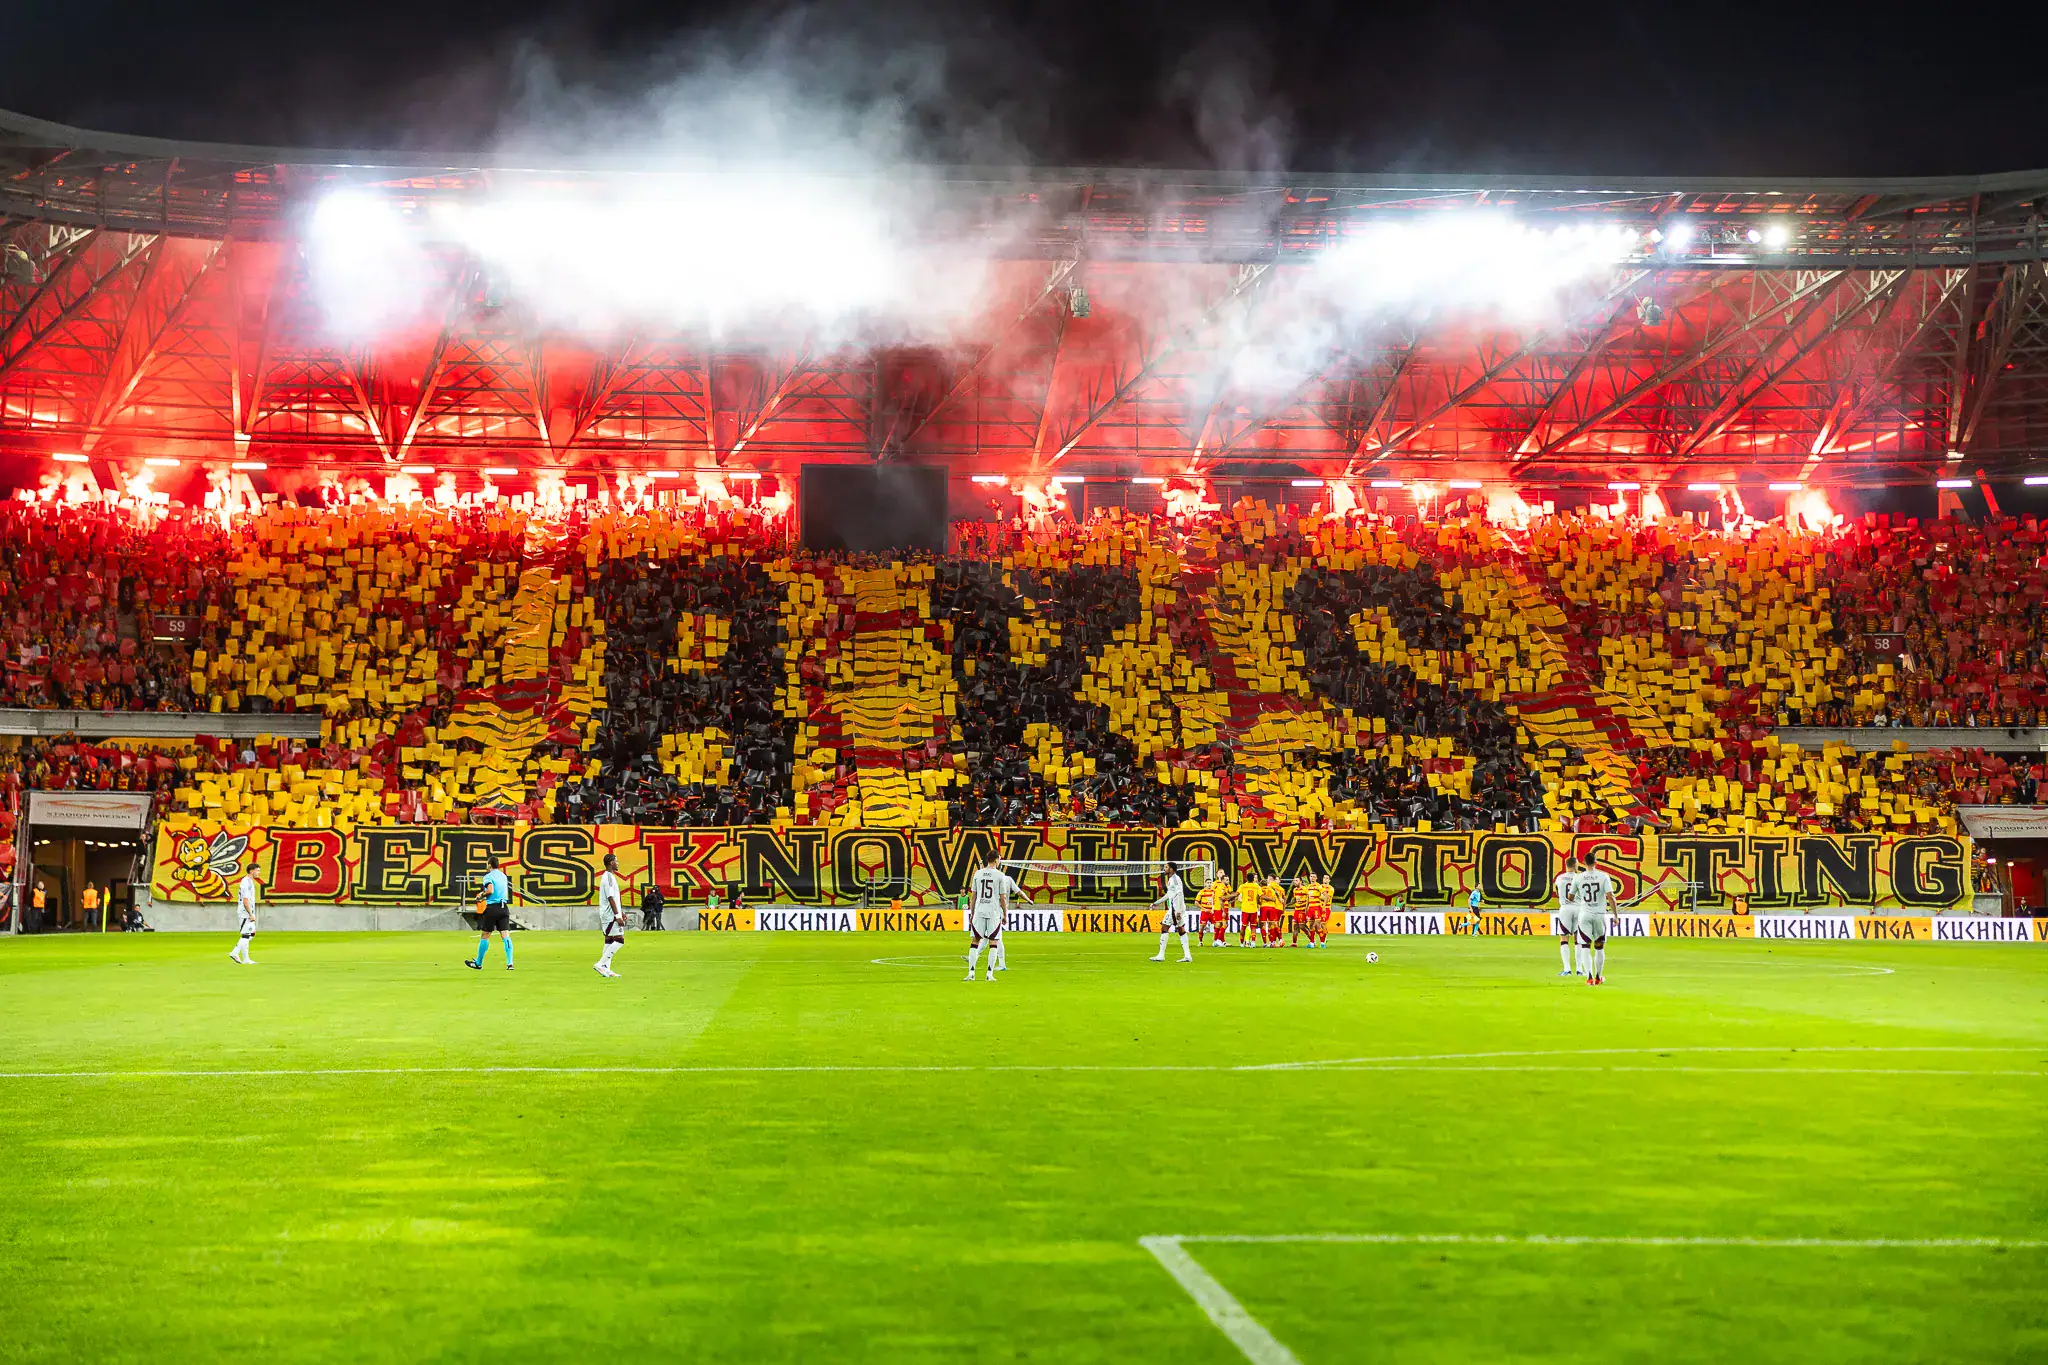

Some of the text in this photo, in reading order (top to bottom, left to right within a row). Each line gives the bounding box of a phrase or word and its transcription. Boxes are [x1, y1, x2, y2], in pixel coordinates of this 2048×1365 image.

[169, 620, 186, 632] 59
[1874, 638, 1890, 650] 58
[46, 811, 90, 819] STADION
[261, 825, 1965, 908] BEES KNOW HOW TO STING
[981, 879, 994, 899] 15
[1247, 890, 1255, 902] 9
[1582, 882, 1600, 903] 37
[760, 912, 851, 931] KUCHNIA
[860, 912, 945, 931] VIKINGA
[1066, 913, 1151, 932] VIKINGA
[1351, 915, 1440, 934] KUCHNIA
[1653, 918, 1738, 938] VIKINGA
[1760, 919, 1850, 939] KUCHNIA
[1858, 920, 1915, 939] VNGA
[1937, 920, 2029, 940] KUCHNIA
